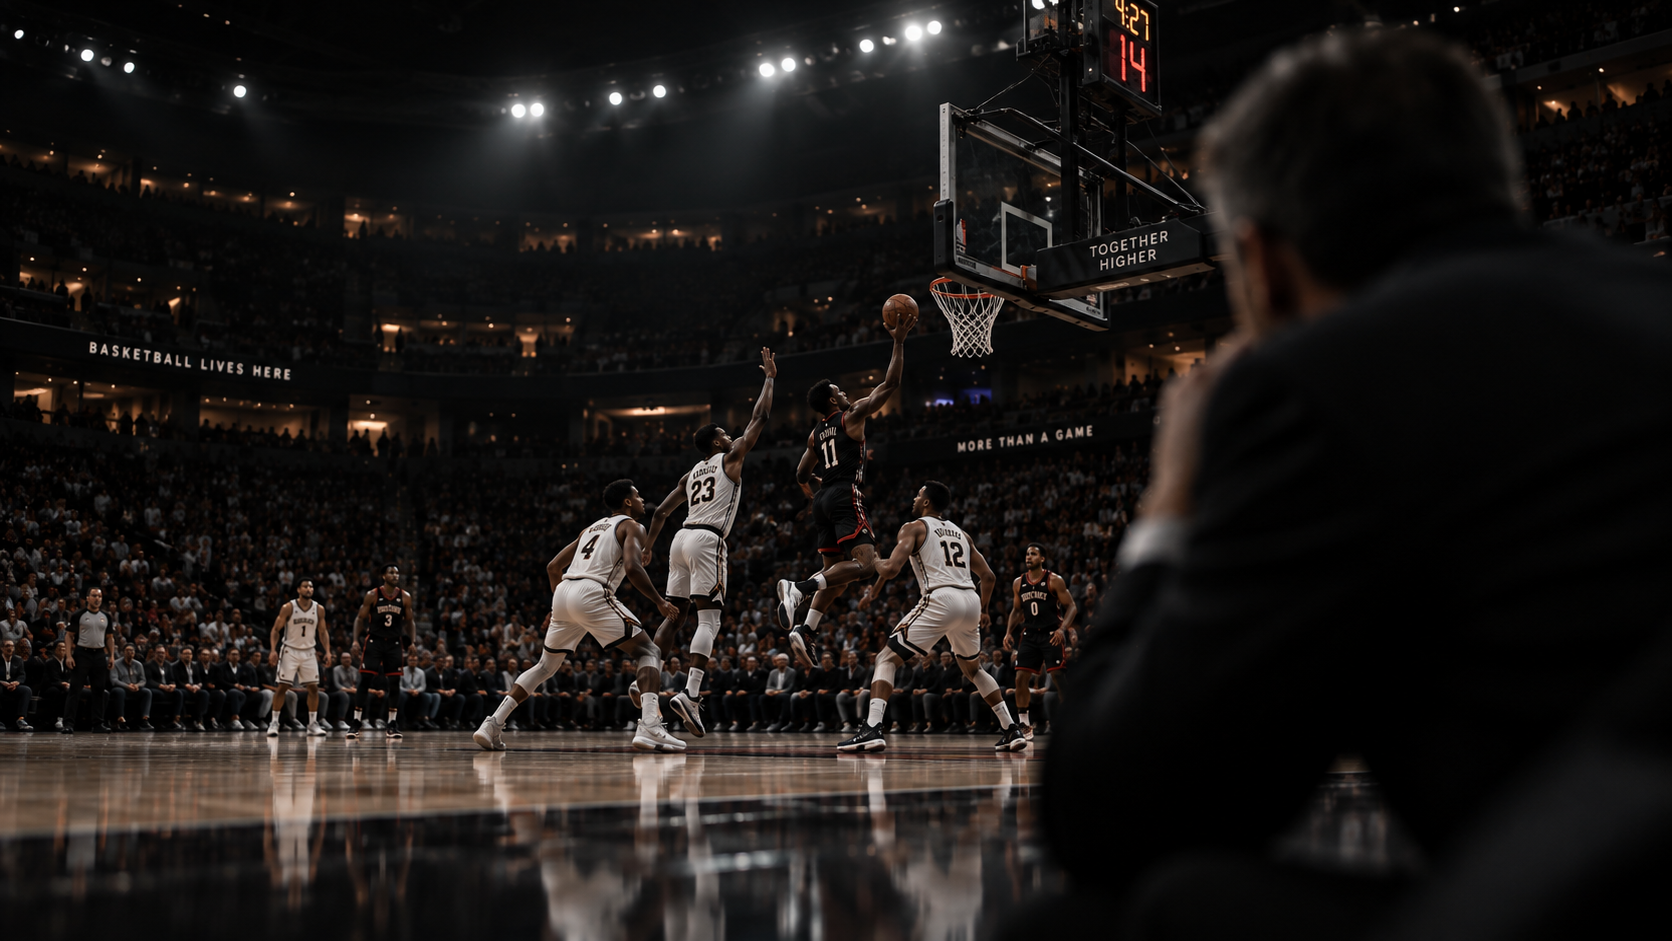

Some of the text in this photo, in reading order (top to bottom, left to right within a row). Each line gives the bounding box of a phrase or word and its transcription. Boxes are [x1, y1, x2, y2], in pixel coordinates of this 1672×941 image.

[1115, 0, 1150, 41] 4:27
[1120, 33, 1146, 93] 14
[1089, 230, 1169, 258] TOGETHER
[1099, 248, 1157, 271] HIGHER
[88, 341, 292, 381] BASKETBALL LIVES HERE
[956, 424, 1094, 453] MORE THAN A GAME
[821, 438, 839, 470] 11
[690, 476, 715, 507] 23
[581, 534, 601, 560] 4
[940, 540, 966, 569] 12
[384, 614, 393, 627] 3
[1030, 602, 1039, 616] 0
[301, 625, 306, 637] 1
